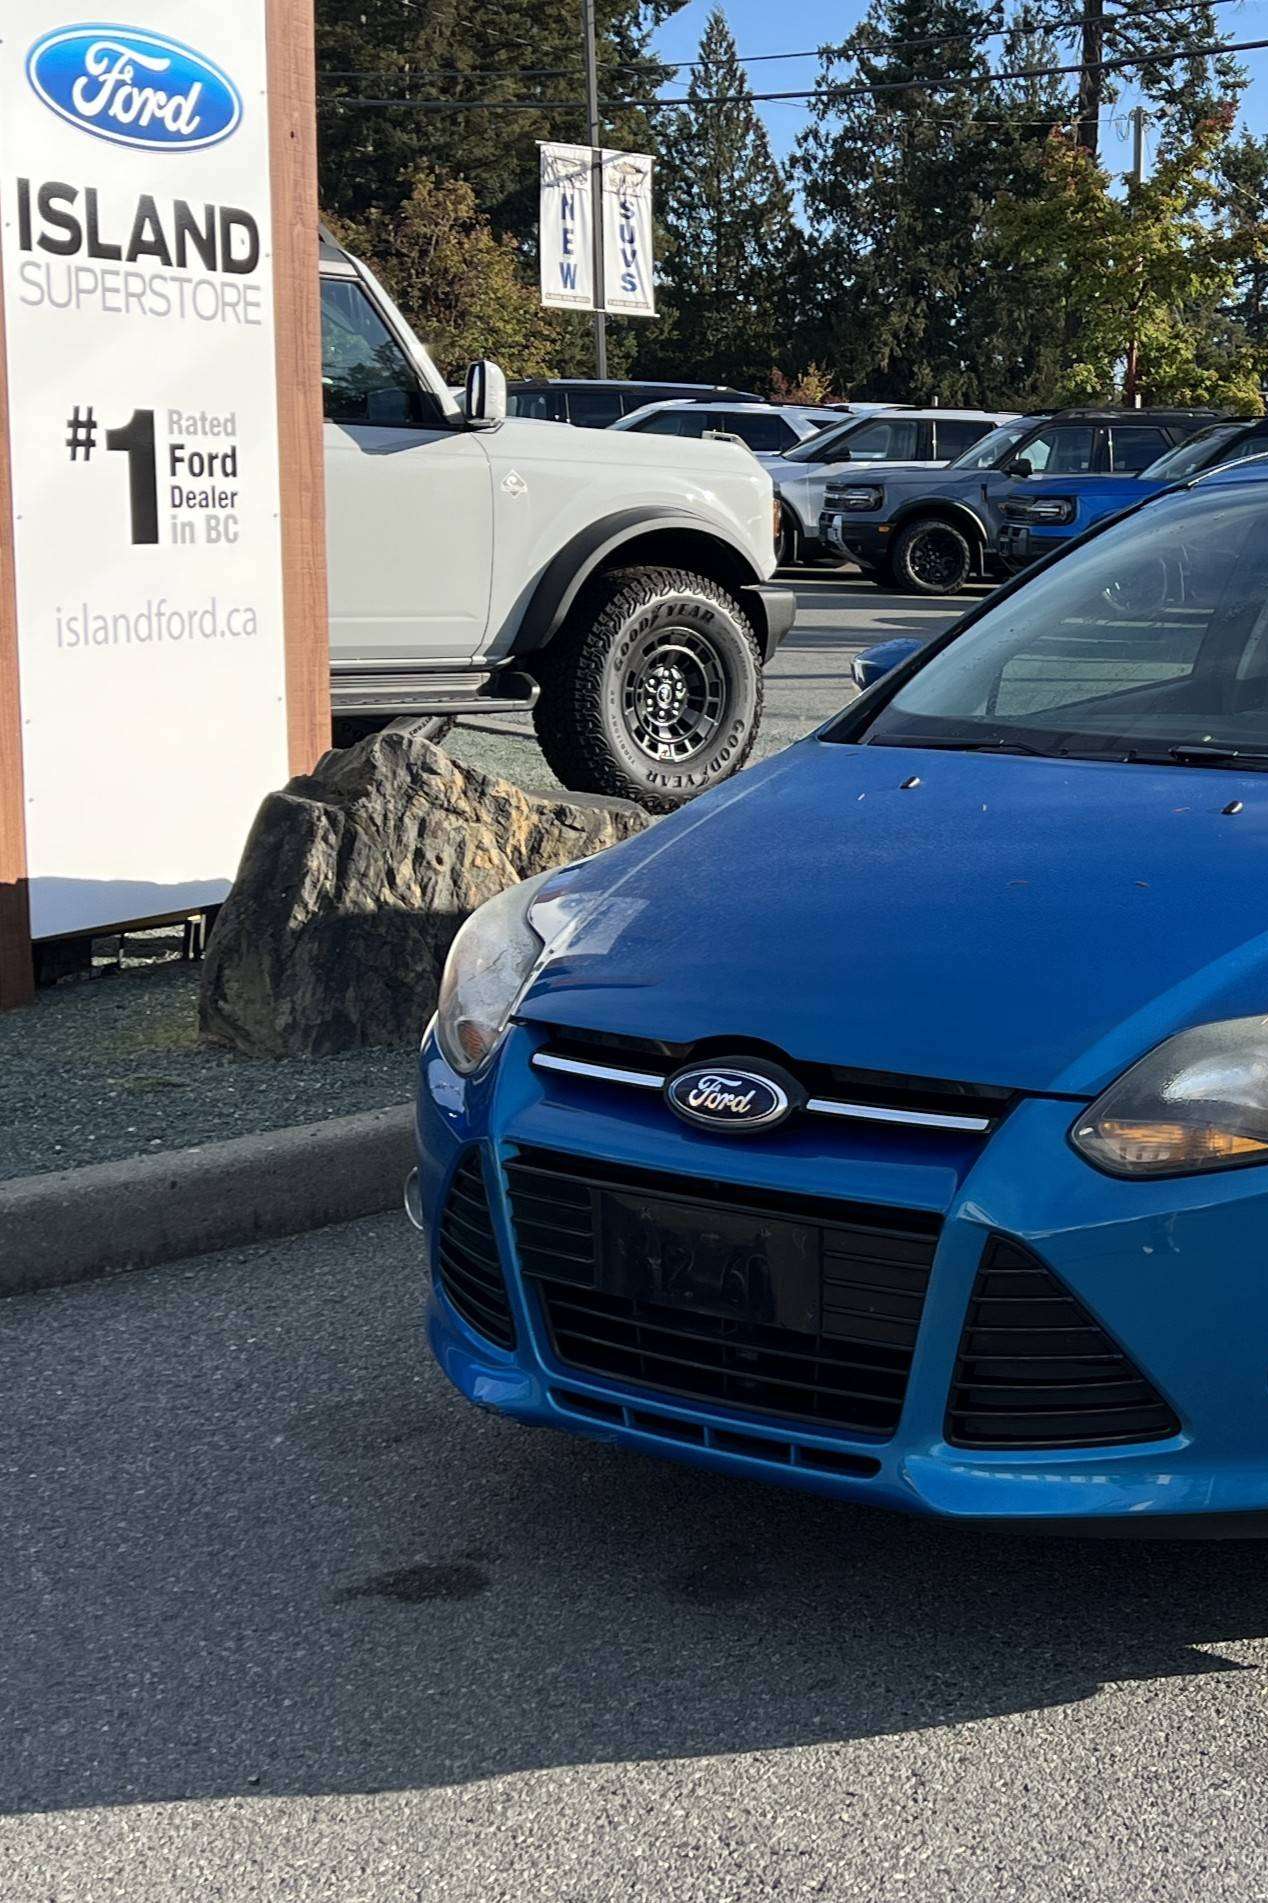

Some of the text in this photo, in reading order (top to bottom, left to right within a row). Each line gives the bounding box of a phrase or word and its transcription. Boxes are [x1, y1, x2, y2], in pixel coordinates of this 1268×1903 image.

[72, 41, 202, 135] Ford
[17, 177, 260, 275] ISLAND
[559, 192, 577, 290] NEW
[619, 202, 638, 292] SUVS
[19, 260, 262, 325] SUPERSTORE
[168, 408, 237, 437] Rated
[169, 443, 238, 477] Ford
[170, 485, 239, 508] Dealer
[170, 513, 240, 544] in BC
[56, 597, 257, 648] islandford.ca
[688, 1075, 756, 1113] Ford
